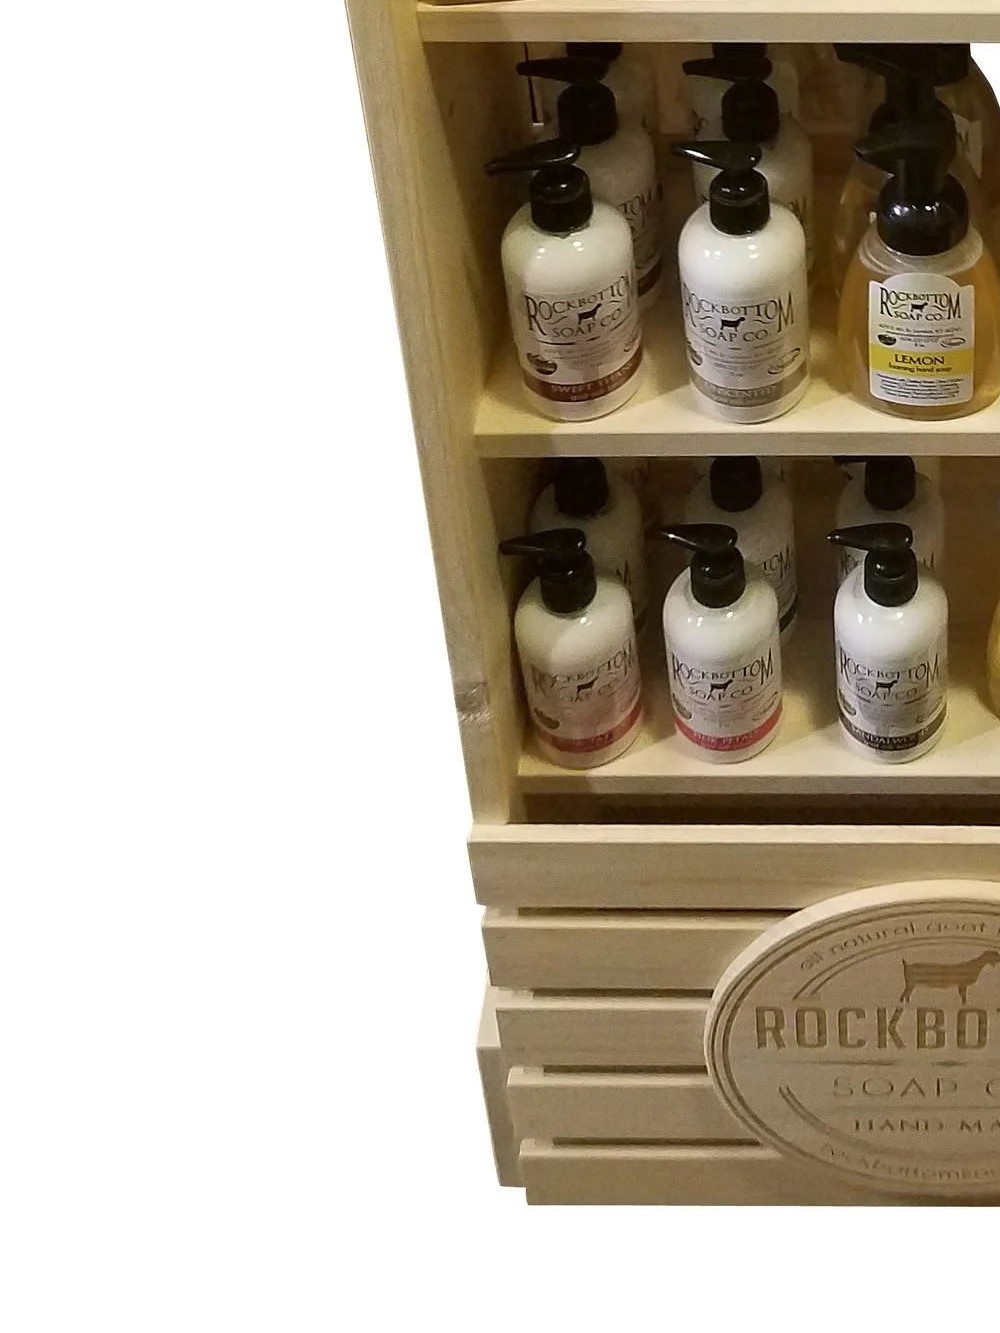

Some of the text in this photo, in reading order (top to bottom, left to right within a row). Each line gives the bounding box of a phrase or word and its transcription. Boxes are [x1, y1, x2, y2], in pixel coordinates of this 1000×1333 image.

[879, 286, 962, 321] ROCKBOTTOM
[893, 310, 923, 322] SOAP
[551, 322, 596, 339] SOAP
[699, 323, 739, 343] SOAP
[894, 353, 945, 365] LEMON
[671, 646, 774, 690] ROCKBOTTOM
[838, 642, 939, 689] ROCKBOTTOM
[799, 947, 825, 971] all
[830, 921, 916, 956] natural
[925, 920, 988, 937] goat
[832, 1074, 959, 1100] SOAP
[854, 1119, 944, 1132] HAND
